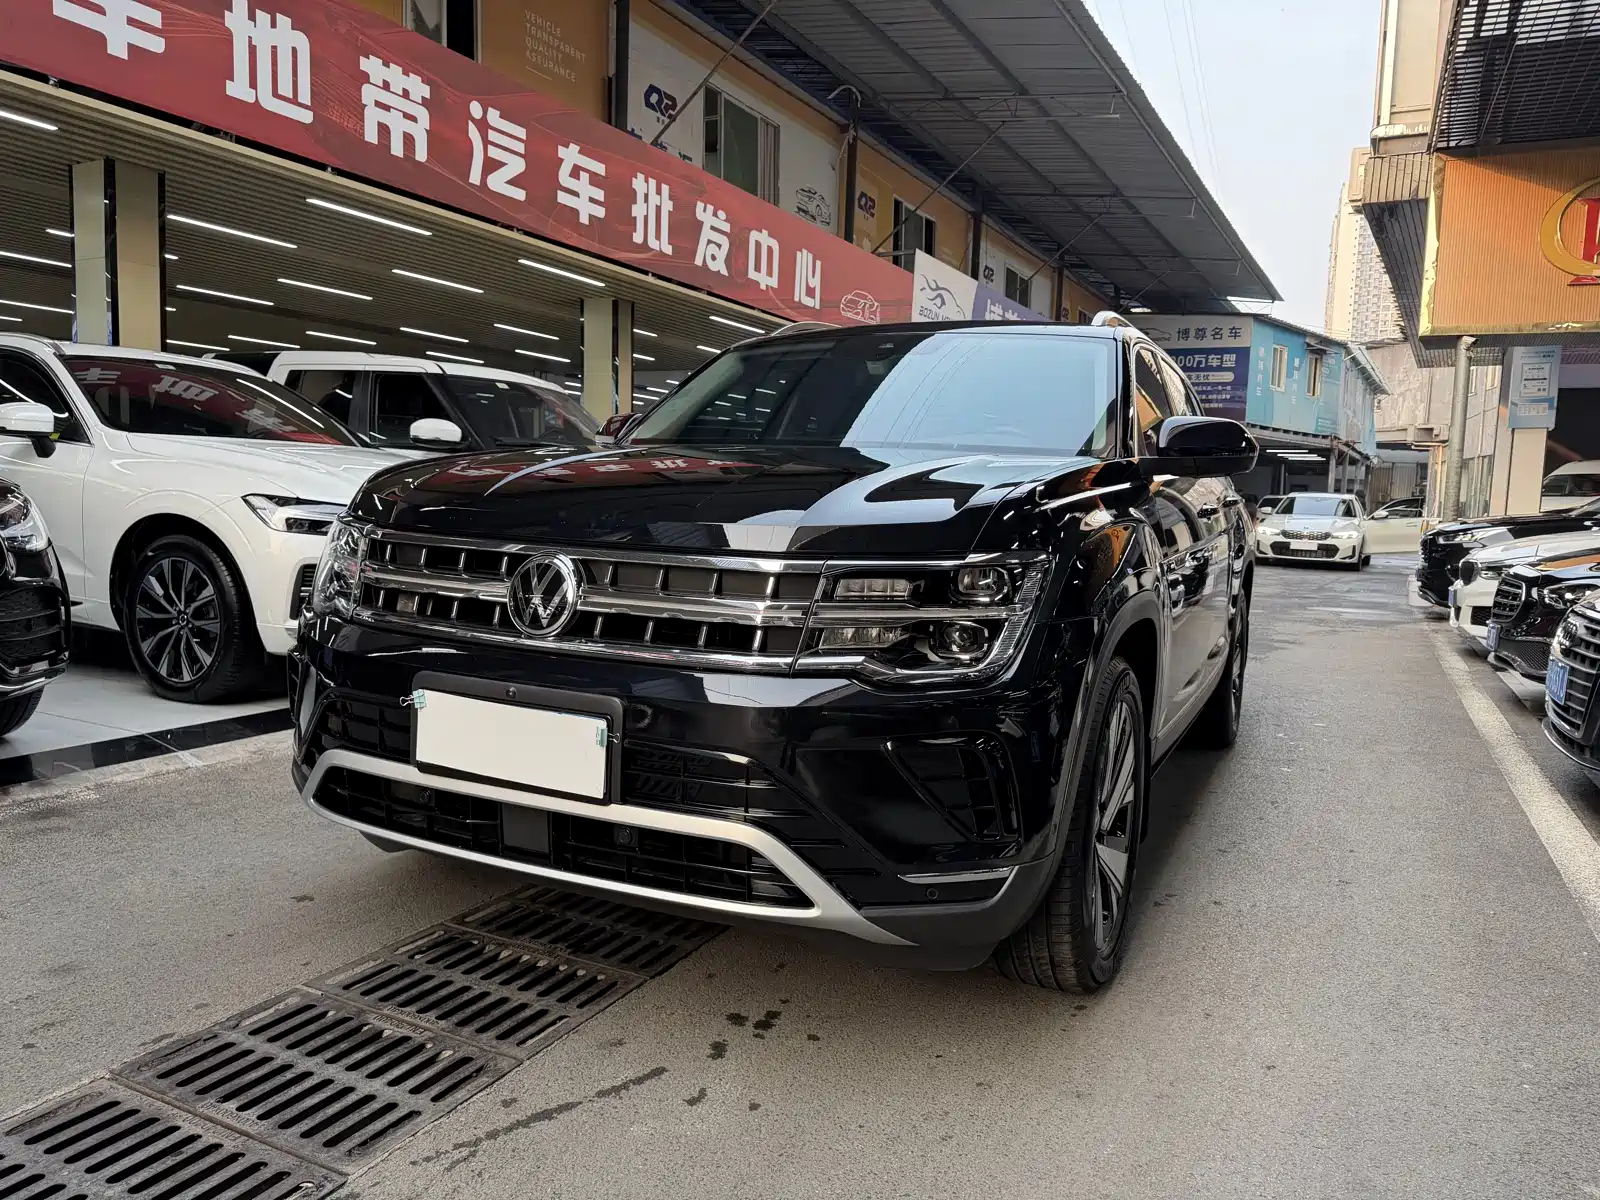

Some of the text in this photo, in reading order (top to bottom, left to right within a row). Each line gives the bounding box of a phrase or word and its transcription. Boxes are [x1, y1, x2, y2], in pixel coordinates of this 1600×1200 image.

[525, 9, 561, 37] VEHICLE
[525, 22, 587, 64] TRANSPARENT
[525, 36, 562, 63] QUALITY
[526, 49, 577, 83] ASSURANCE
[1177, 326, 1242, 342] 博尊名车
